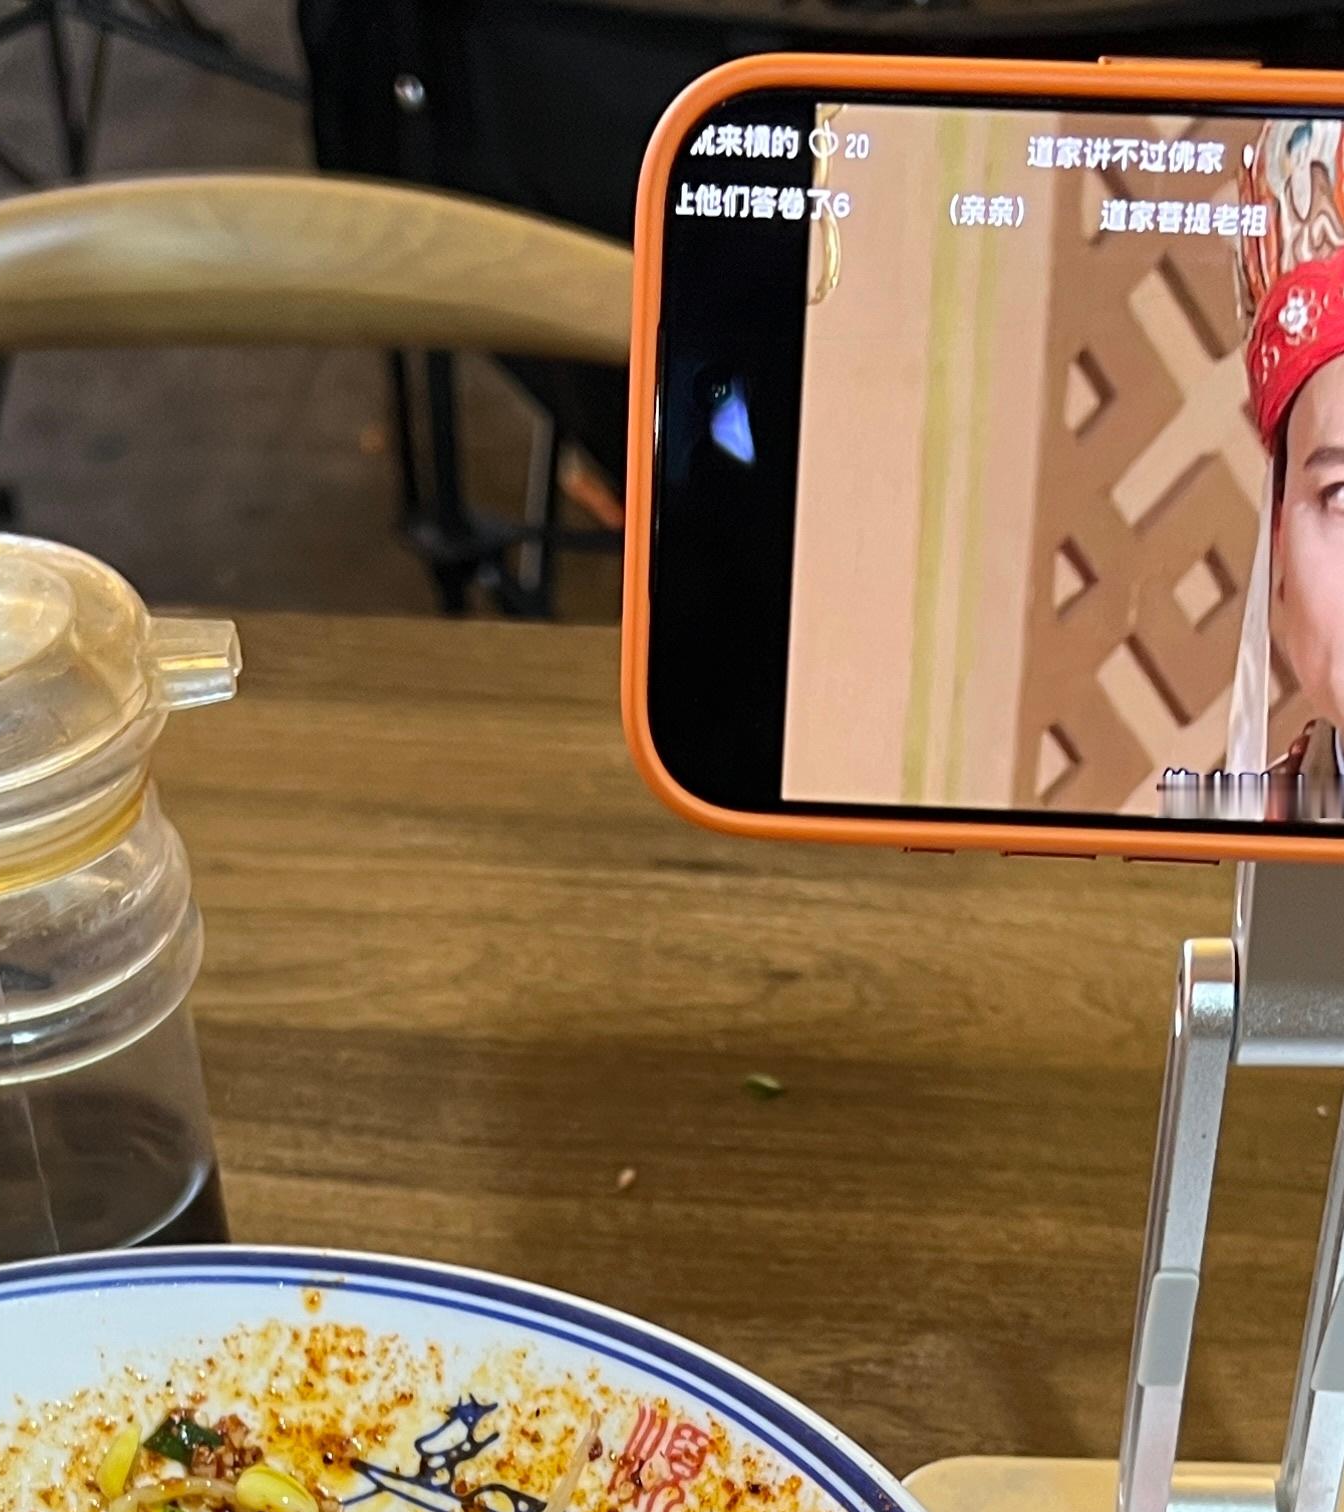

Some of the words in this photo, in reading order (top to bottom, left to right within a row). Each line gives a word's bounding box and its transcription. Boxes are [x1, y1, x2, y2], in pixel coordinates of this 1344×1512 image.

[844, 132, 869, 159] 20
[1027, 136, 1224, 173] 道家讲不过佛家
[1099, 199, 1267, 237] 道家菩提老祖
